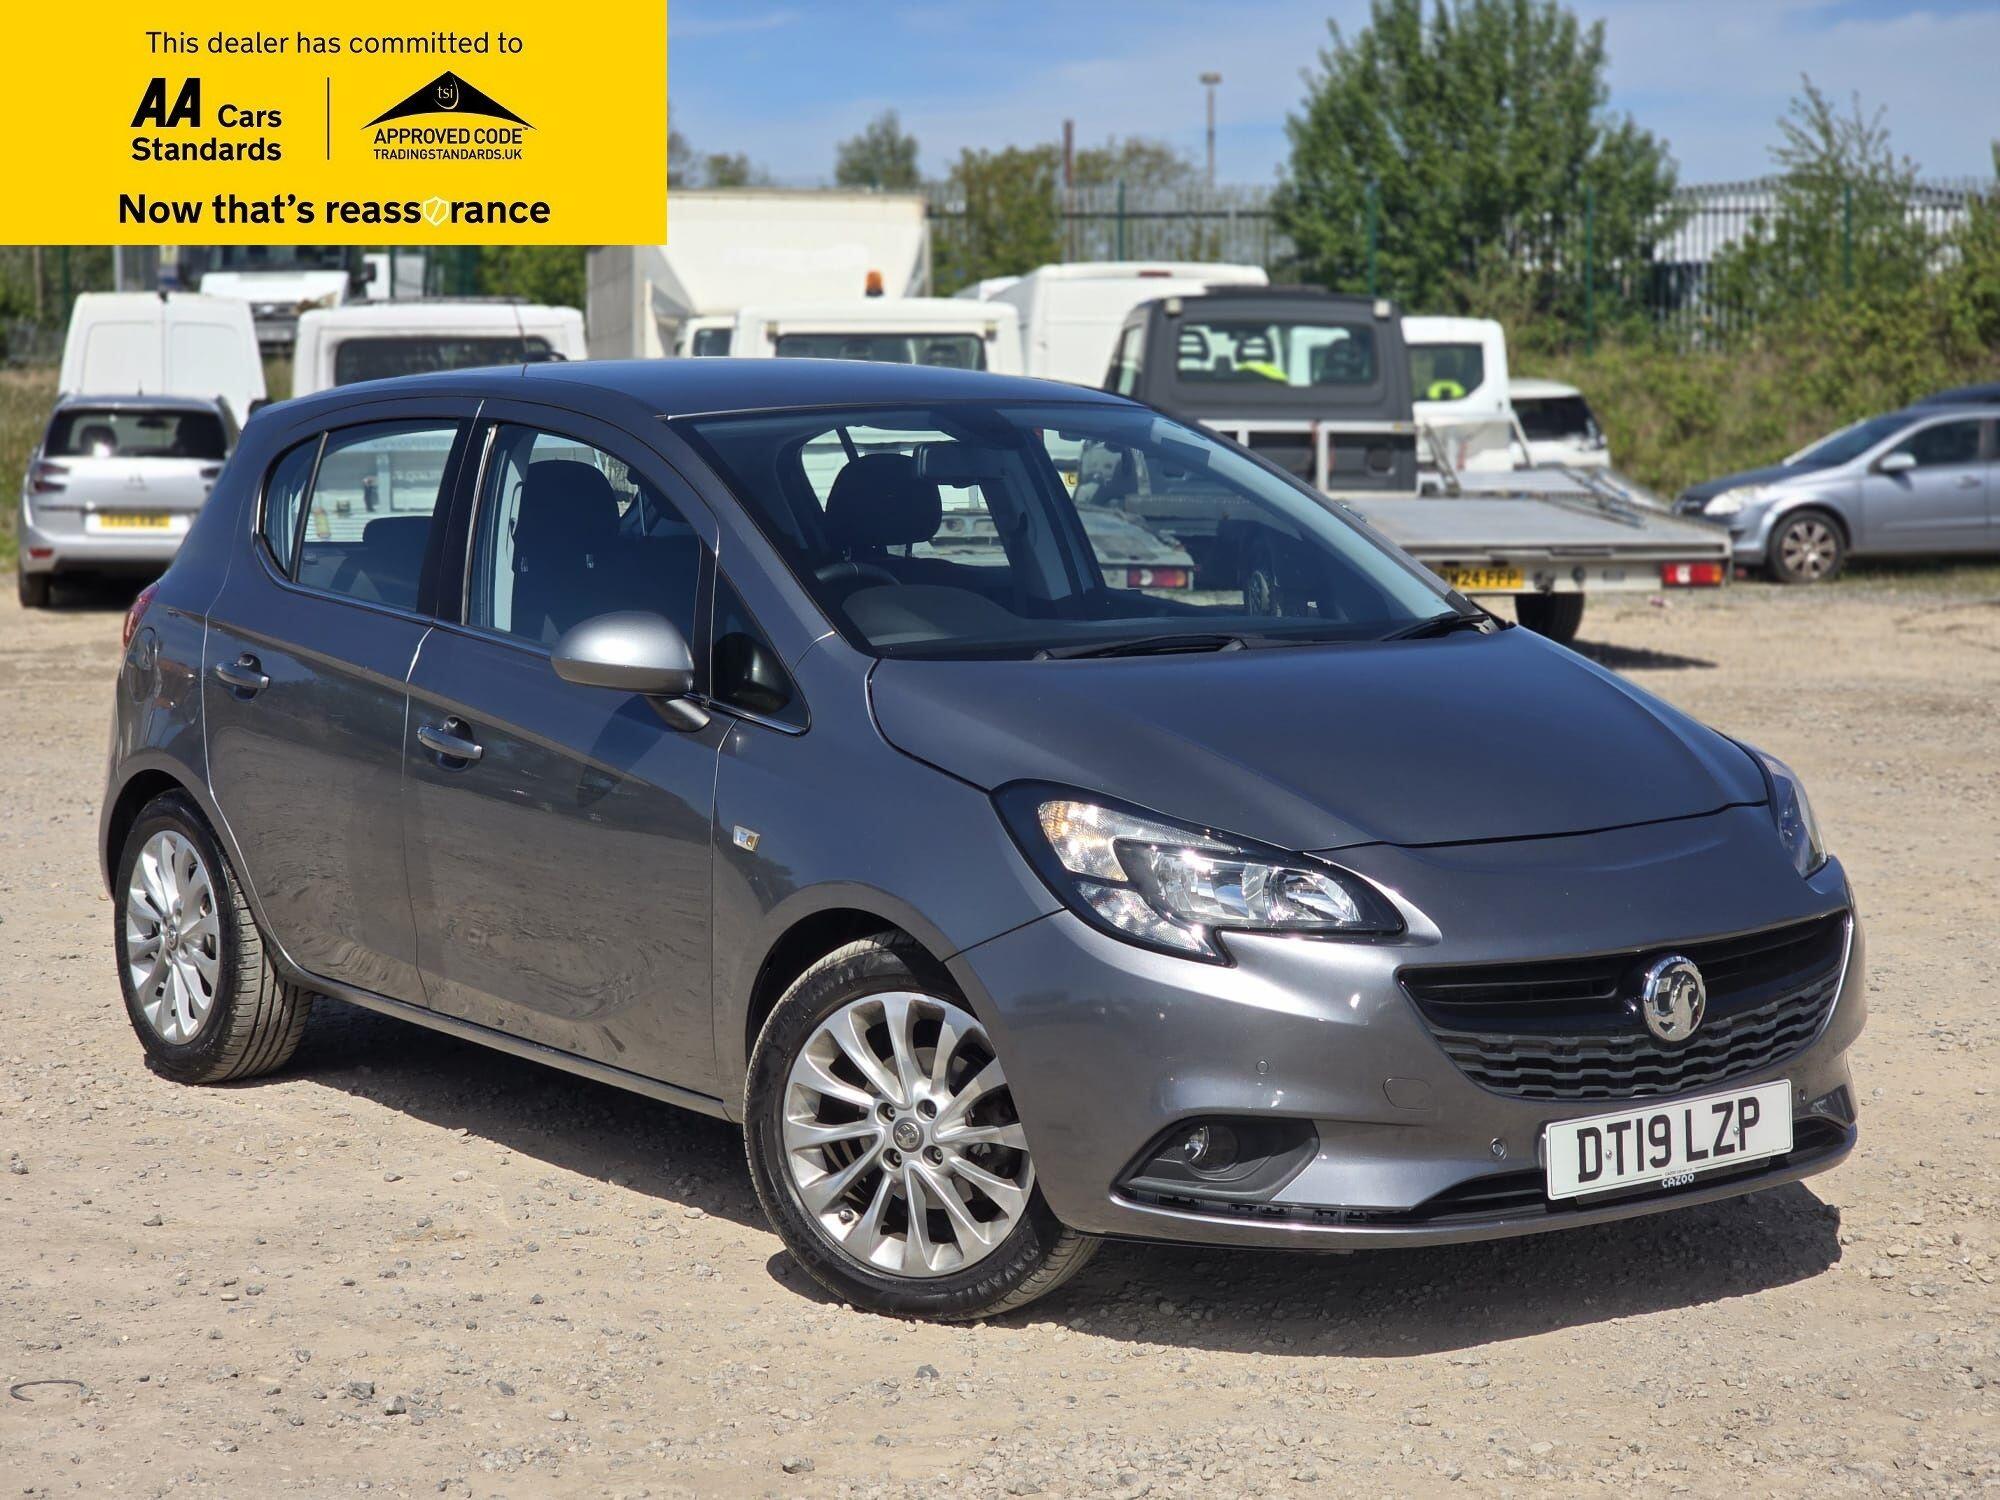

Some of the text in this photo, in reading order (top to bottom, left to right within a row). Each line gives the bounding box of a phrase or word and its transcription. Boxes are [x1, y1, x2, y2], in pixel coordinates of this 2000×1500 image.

[1577, 1097, 1760, 1183] DT19 LZP
[1662, 1173, 1695, 1189] CAZOO
